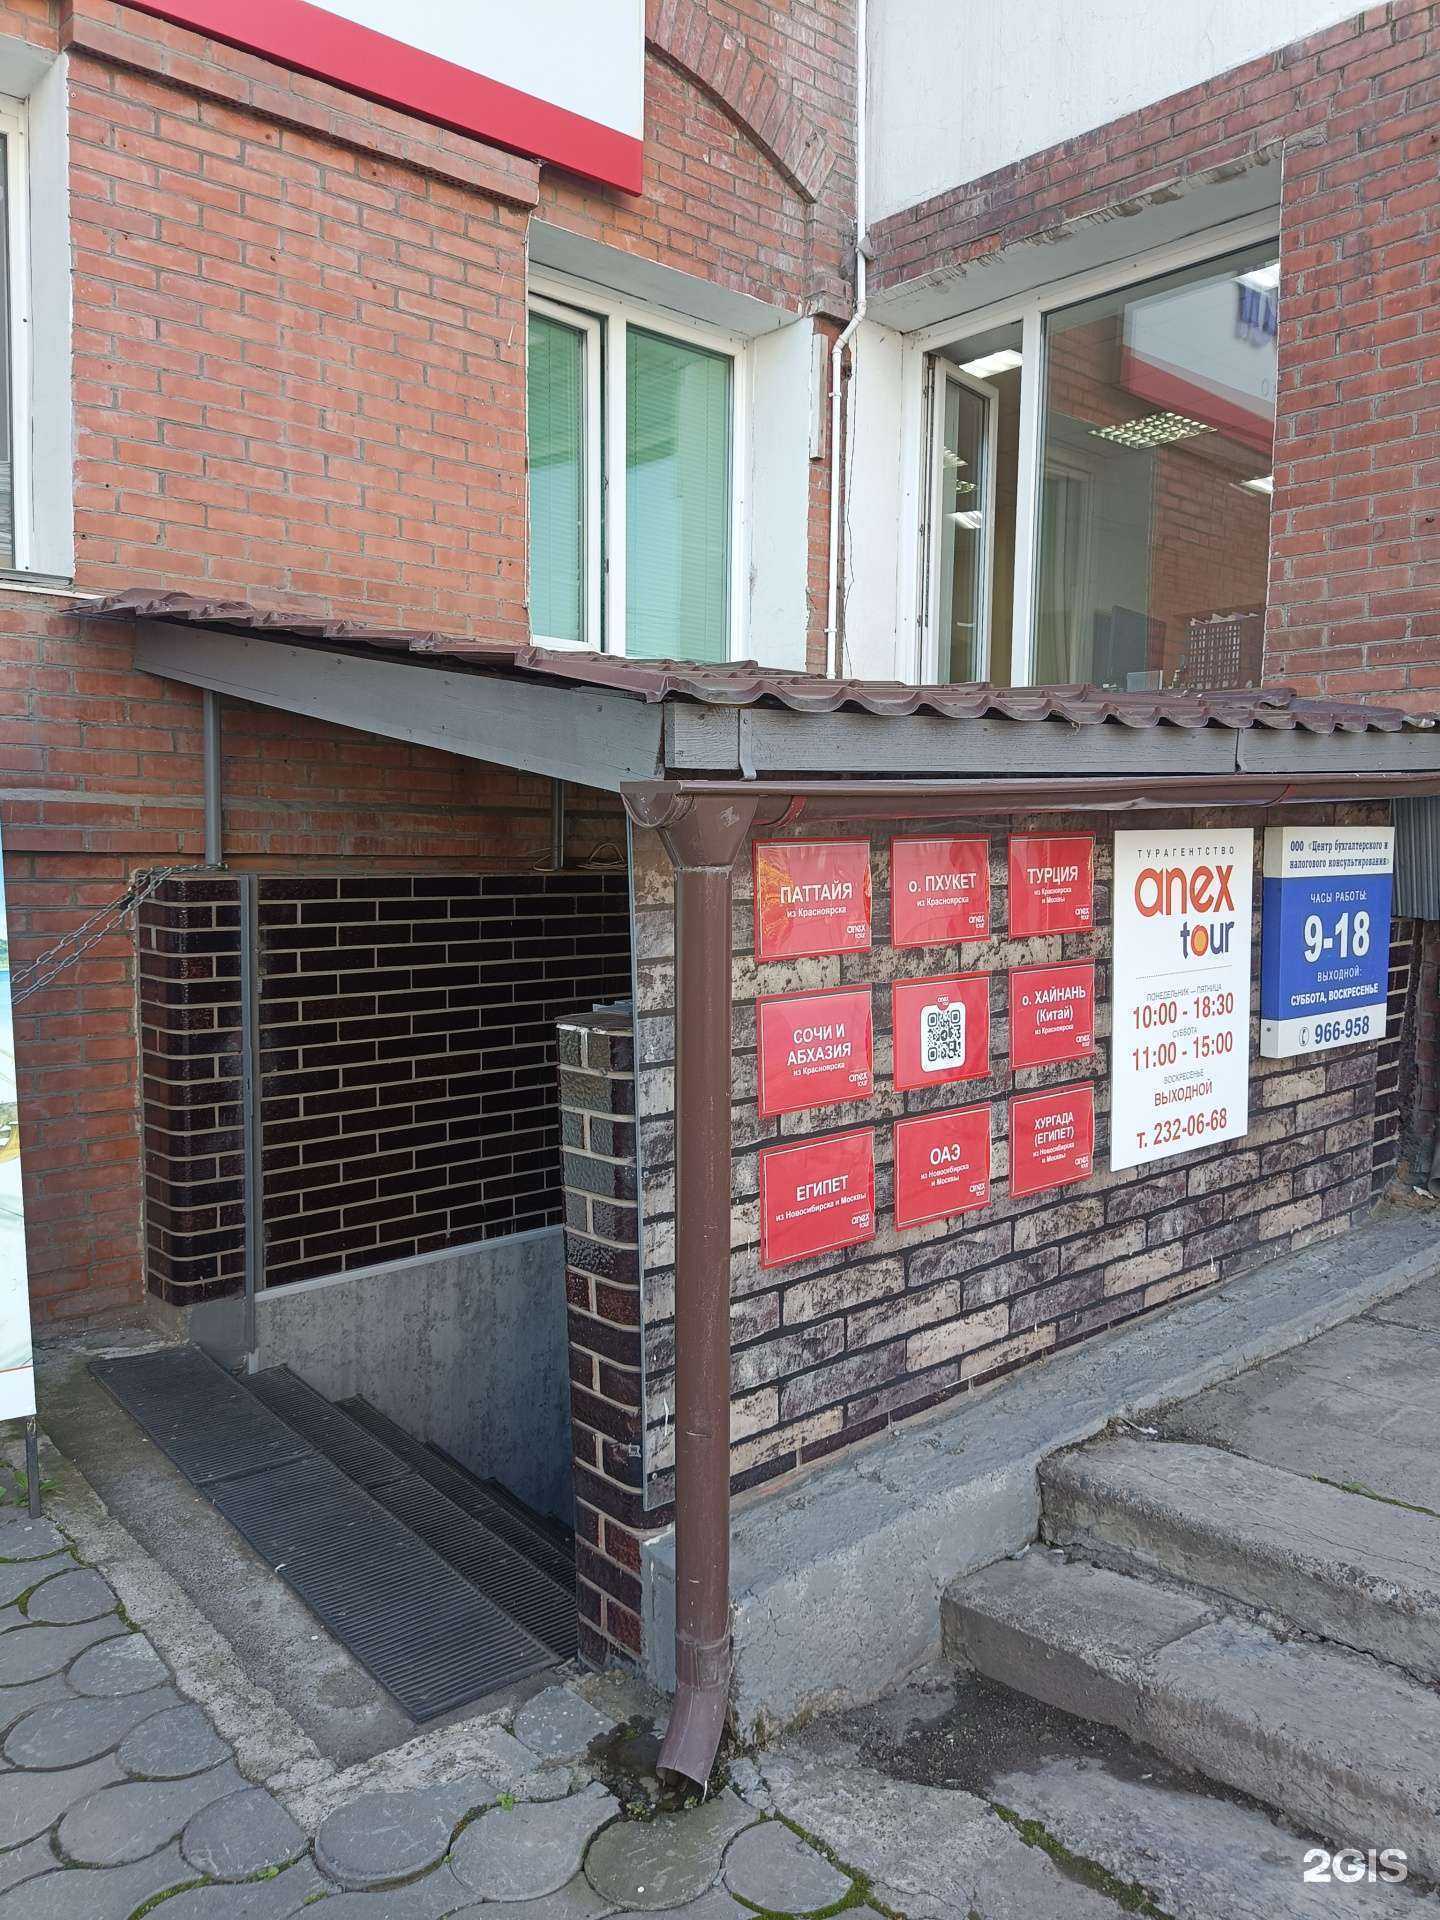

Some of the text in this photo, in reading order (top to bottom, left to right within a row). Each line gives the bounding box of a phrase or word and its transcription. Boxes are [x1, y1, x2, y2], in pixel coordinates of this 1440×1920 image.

[1138, 846, 1235, 858] ТУРАГЕНТСТВО
[1290, 840, 1304, 852] ООО
[1334, 840, 1382, 853] бухгалтерского
[1290, 860, 1326, 868] налогового
[908, 873, 976, 892] о. ПХУКЕТ
[1026, 866, 1079, 885] ТУРЦИЯ
[780, 880, 853, 904] ПАТТАЙЯ
[1042, 887, 1072, 896] Красноярска
[1046, 896, 1066, 904] Москвы
[1134, 864, 1235, 918] anex
[1310, 892, 1332, 903] ЧАСЫ
[926, 896, 969, 908] Красноярска
[787, 906, 847, 918] из Красноярска
[1180, 921, 1235, 960] tour
[1304, 910, 1370, 963] 9-18
[1317, 964, 1362, 982] ВЫХОДНОЙ:
[1022, 986, 1086, 1006] о. ХАЙНАНЬ
[1290, 983, 1379, 1006] СУББОТА, ВОСКРЕСЕНЬЕ
[1036, 1005, 1073, 1026] (Китай)
[1133, 1001, 1177, 1030] 10:00
[1194, 992, 1234, 1018] 18:30
[793, 1024, 845, 1044] СОЧИ И
[1042, 1024, 1074, 1035] Красноярска
[1172, 1026, 1198, 1038] СУББОТА
[1314, 1016, 1370, 1044] 966-958
[786, 1042, 852, 1066] АБХАЗИЯ
[1132, 1042, 1176, 1071] 11:00
[1193, 1030, 1234, 1058] 15:00
[802, 1062, 845, 1074] Красноярска
[1164, 1068, 1204, 1084] ВОСКРЕСЕНЬЕ
[1154, 1078, 1213, 1106] ВЫХОДНОЙ
[1034, 1112, 1074, 1130] ХУРГАДА
[1153, 1108, 1228, 1146] 232-06-68
[1034, 1126, 1074, 1147] (ЕГИПЕТ)
[930, 1144, 960, 1166] ОАЭ
[1040, 1142, 1074, 1156] Новосибирска
[1046, 1153, 1066, 1162] Москвы
[928, 1164, 970, 1178] Новосибирска
[936, 1176, 960, 1185] Москвы
[796, 1174, 848, 1202] ЕГИПЕТ
[776, 1214, 784, 1222] из
[786, 1201, 834, 1219] Новосибирска
[840, 1193, 866, 1205] Москвы
